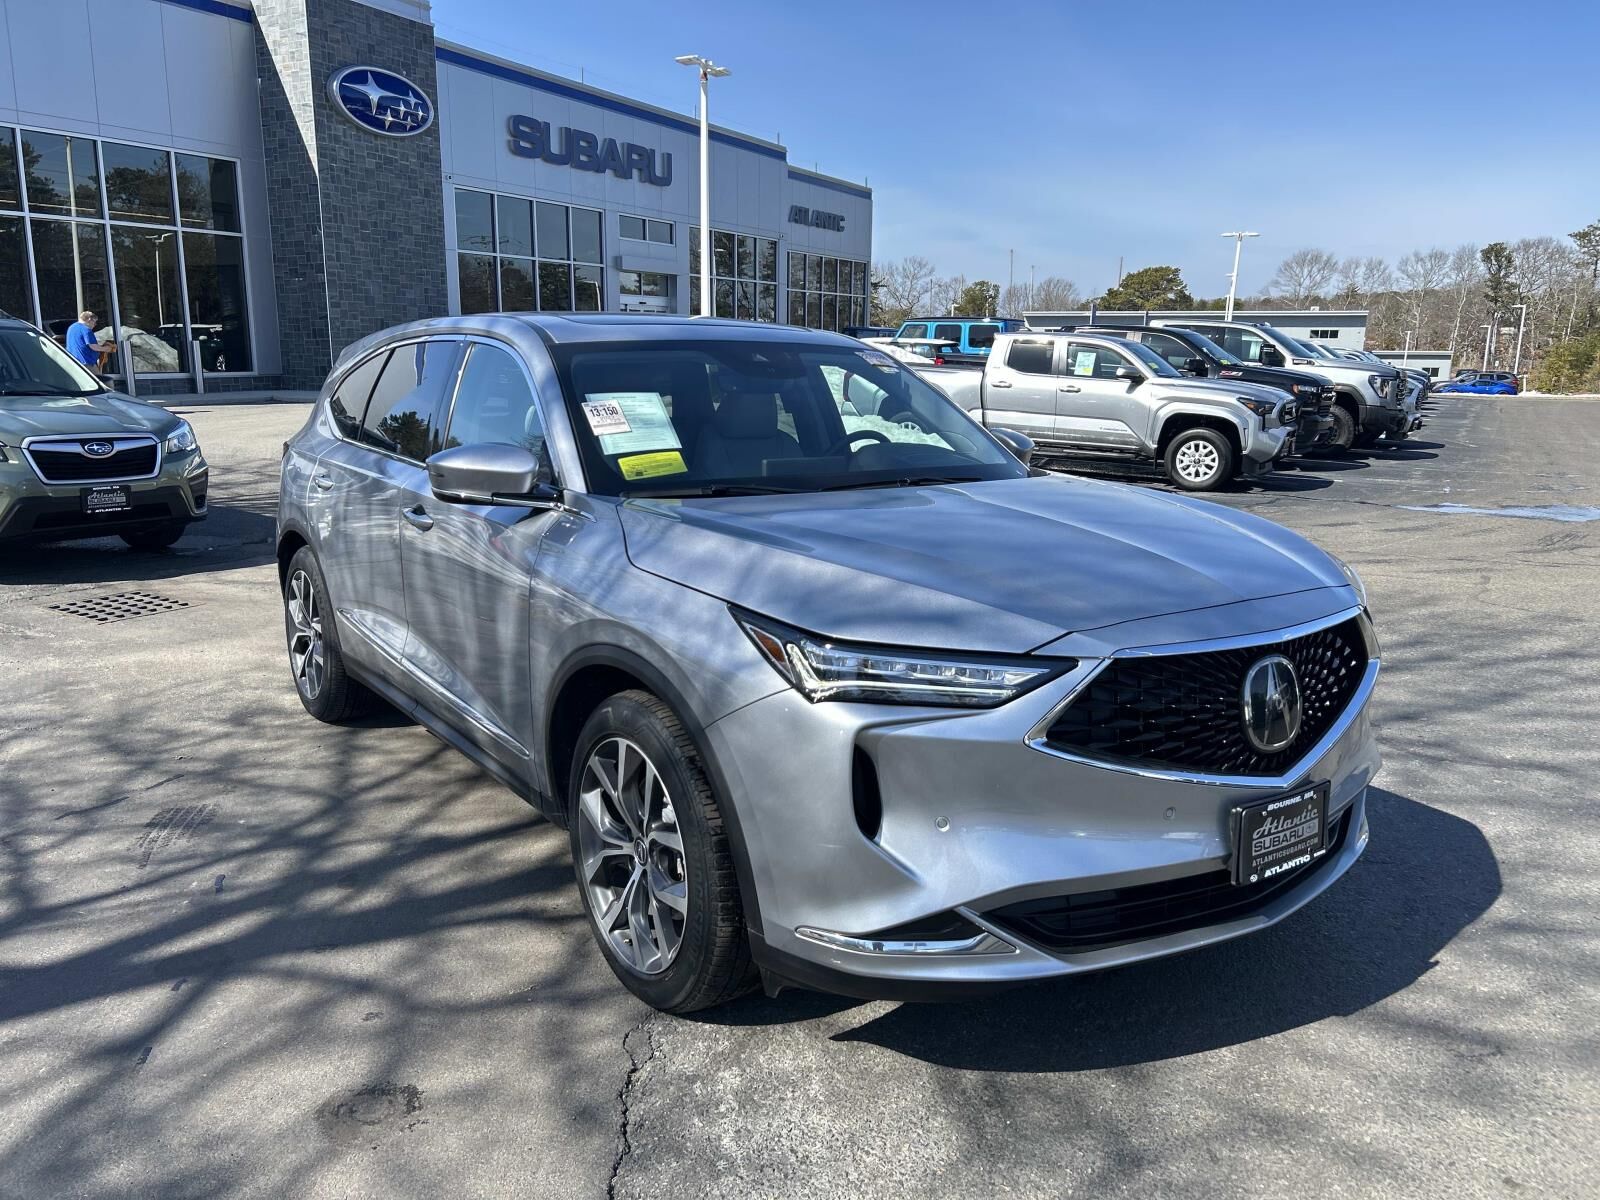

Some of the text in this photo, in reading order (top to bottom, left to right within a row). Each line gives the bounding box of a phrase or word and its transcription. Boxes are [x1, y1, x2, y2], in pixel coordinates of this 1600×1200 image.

[507, 114, 673, 187] SUBARU
[788, 205, 845, 232] ATLANTIC
[88, 490, 125, 498] Atlantic
[1252, 804, 1319, 839] Atlantic
[1252, 837, 1319, 867] ATLANTICSUBARU.COM
[1253, 830, 1305, 853] SUBARU
[1264, 855, 1311, 877] ATLANTIC
